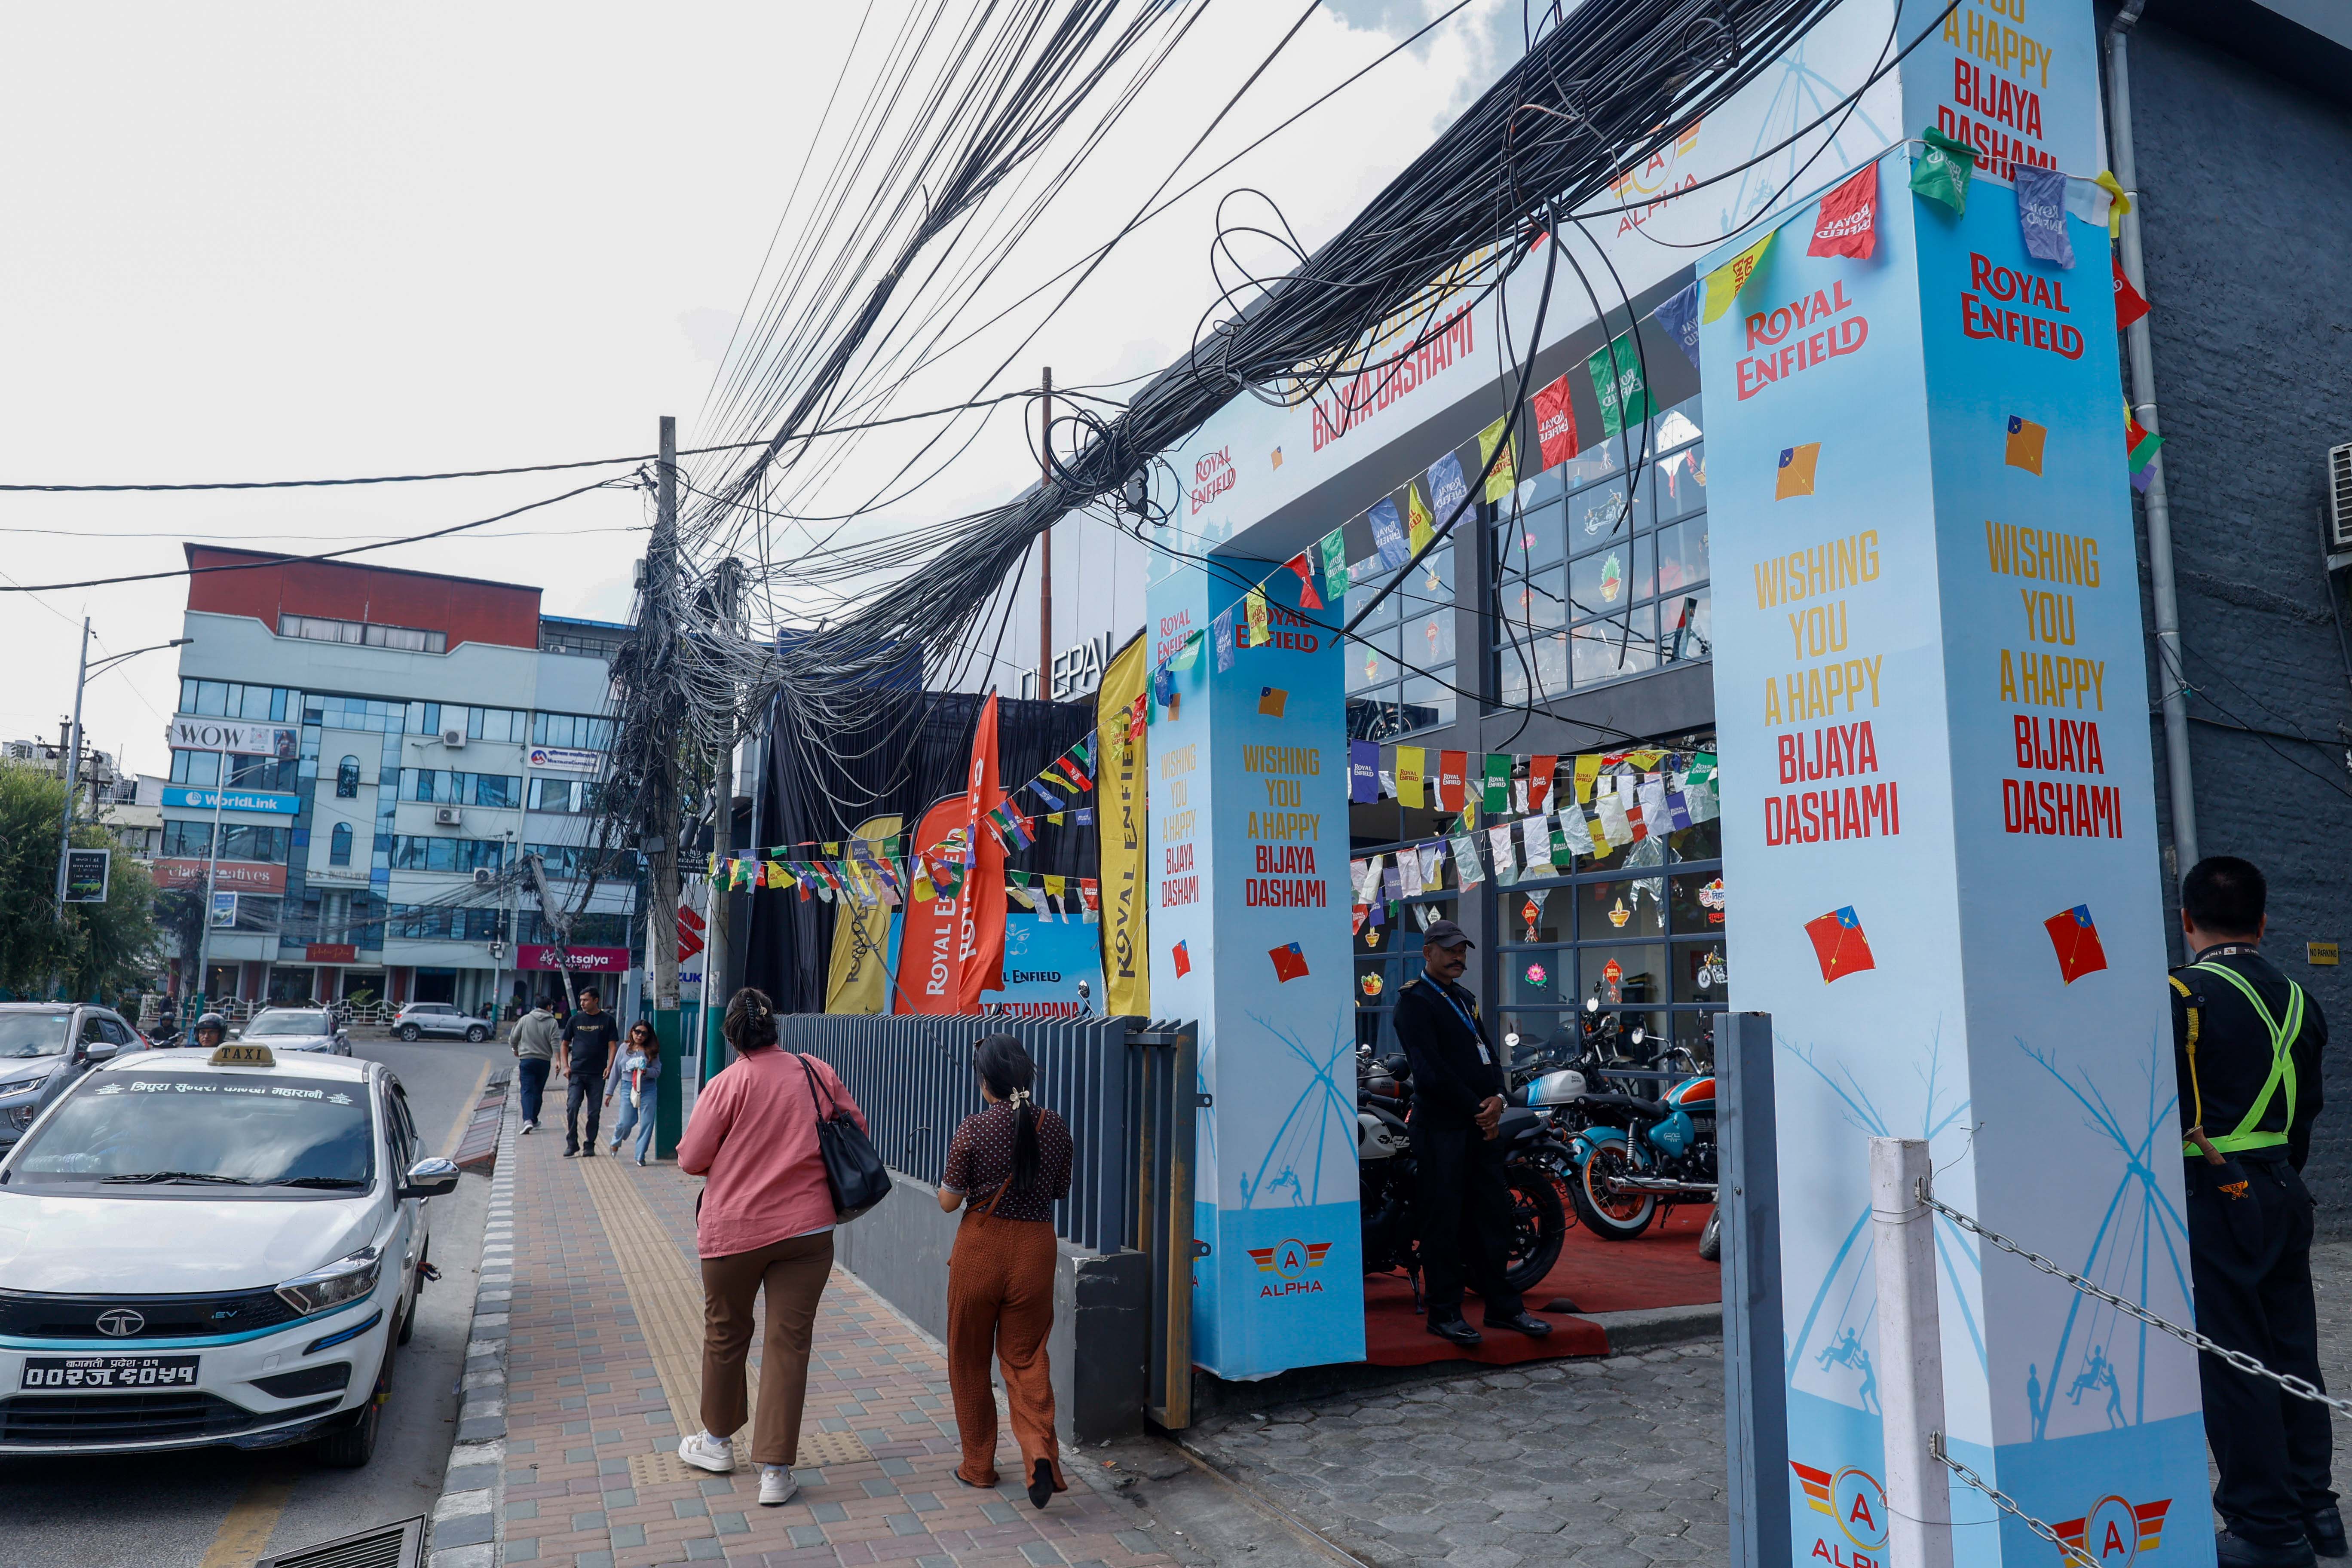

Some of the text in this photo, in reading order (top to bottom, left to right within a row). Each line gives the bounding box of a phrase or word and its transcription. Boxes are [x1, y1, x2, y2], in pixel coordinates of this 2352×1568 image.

[1967, 9, 2053, 89] HAPPY
[1954, 57, 2043, 141] BIJAYA
[1969, 251, 2070, 313] ROYAL
[1745, 279, 1852, 352] ROYAL
[1960, 291, 2084, 361] ENFIELD
[1313, 300, 1473, 453] BIJAYA DASHAMI
[1736, 316, 1869, 401] ENFIELD
[1195, 445, 1231, 485] ROYAL
[1191, 468, 1236, 515] ENFIELD
[1754, 529, 1880, 610] WISHING
[1985, 520, 2100, 588] WISHING
[1161, 608, 1191, 638] ROYAL
[1788, 600, 1847, 660] YOU
[2020, 588, 2076, 646] YOU
[1765, 653, 1883, 727] A HAPPY
[2000, 649, 2104, 712] A HAPPY
[180, 724, 245, 747] WOW
[1777, 720, 1878, 785] BIJAYA
[2013, 714, 2104, 775] BIJAYA
[1161, 743, 1197, 780] WISHING
[1243, 744, 1320, 775] WISHING
[1354, 769, 1374, 777] ENFIELD
[1400, 774, 1418, 782] ENFIELD
[1170, 779, 1188, 809] YOU
[1265, 779, 1301, 807] YOU
[2002, 778, 2122, 839] DASHAMI
[1163, 808, 1197, 843] A HAPPY
[1247, 812, 1320, 841] A HAPPY
[1764, 781, 1900, 847] DASHAMI
[1167, 843, 1194, 875] BIJAYA
[1256, 845, 1316, 874] BIJAYA
[1162, 875, 1199, 908] DASHAMI
[1246, 879, 1326, 908] DASHAMI
[1118, 874, 1135, 979] ROYAL
[926, 923, 951, 995] ROYAL
[2310, 949, 2337, 958] NO PARKING
[1013, 970, 1061, 983] ENFIELD
[222, 1048, 261, 1060] TAXI
[130, 1081, 171, 1092] त्रिपुरा
[271, 1087, 323, 1099] महारानी
[1284, 1251, 1298, 1269] A
[1260, 1280, 1323, 1298] ALPHA
[66, 1358, 104, 1368] बागमती
[1849, 1492, 1875, 1532] A
[2102, 1521, 2125, 1559] A
